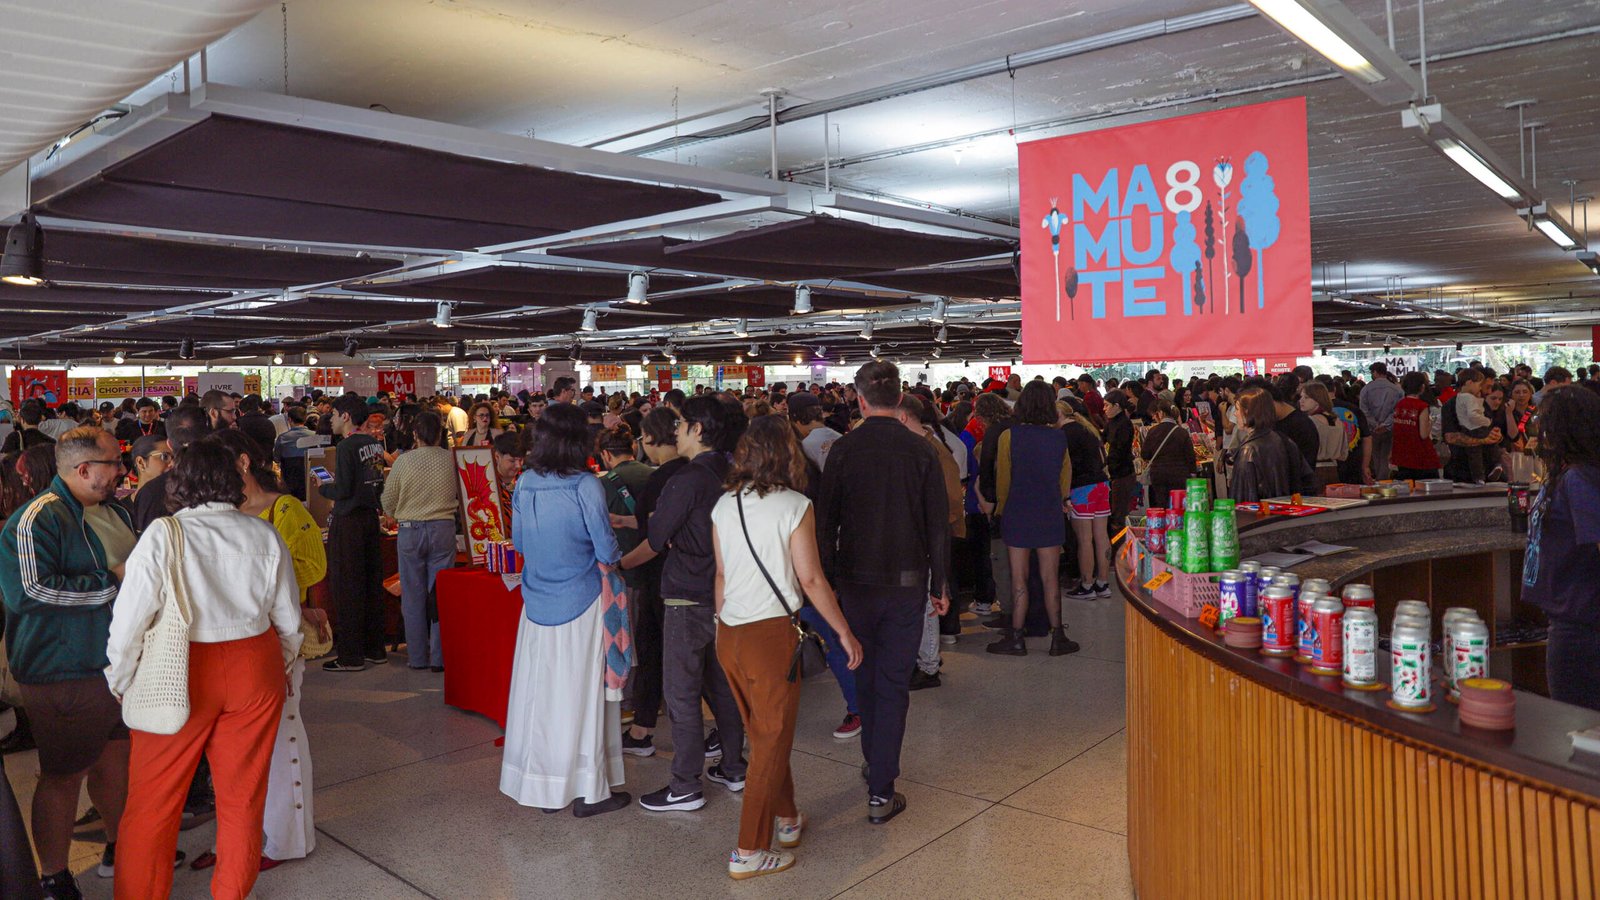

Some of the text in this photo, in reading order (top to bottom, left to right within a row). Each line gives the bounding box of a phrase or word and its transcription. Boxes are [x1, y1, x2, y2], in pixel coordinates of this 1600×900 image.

[1072, 160, 1203, 221] MA 8
[1073, 214, 1165, 270] MU
[1077, 266, 1166, 319] TE
[991, 367, 1004, 375] MA
[384, 373, 404, 384] MA
[131, 385, 180, 393] ARTESANAL
[394, 383, 414, 394] MU
